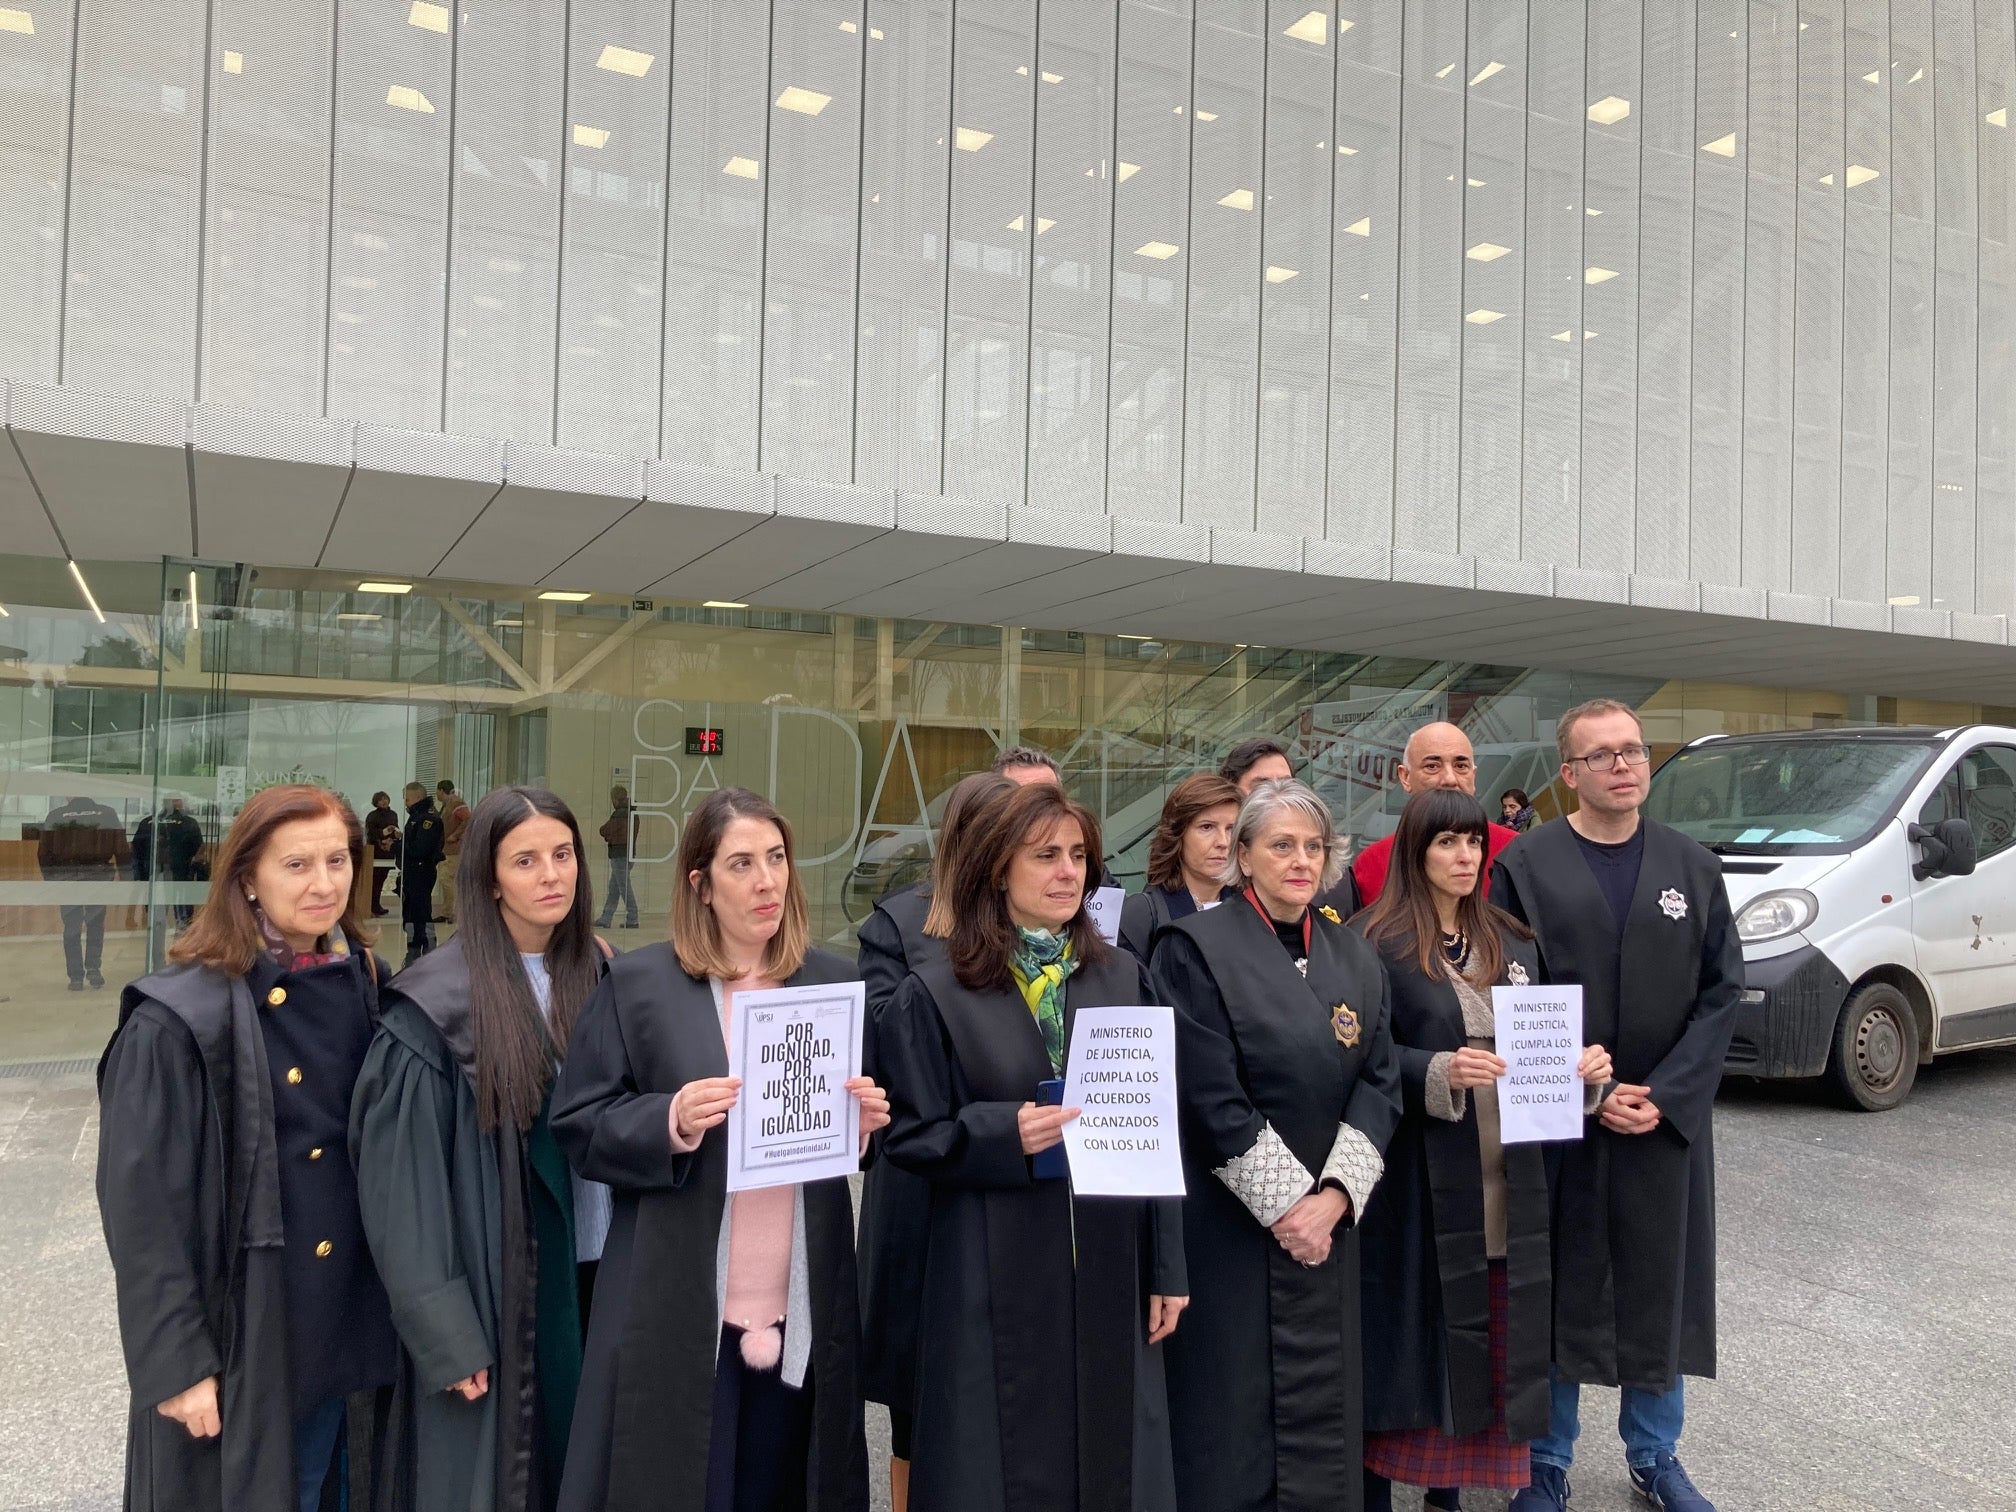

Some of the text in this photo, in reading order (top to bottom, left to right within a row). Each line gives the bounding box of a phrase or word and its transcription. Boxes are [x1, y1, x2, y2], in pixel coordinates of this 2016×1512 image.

[633, 699, 711, 752] CI
[254, 770, 315, 785] XUNTA
[631, 754, 721, 808] DA
[1513, 1002, 1567, 1012] MINISTERIO
[1513, 1020, 1568, 1031] DE JUSTICIA,
[785, 1022, 814, 1043] POR
[1089, 1027, 1153, 1039] MINISTERIO
[761, 1038, 835, 1064] DIGNIDAD,
[1511, 1038, 1572, 1051] ¡CUMPLA LOS
[1086, 1048, 1154, 1061] DE JUSTICIA,
[1517, 1056, 1566, 1067] ACUERDOS
[784, 1058, 812, 1081] POR
[1080, 1071, 1159, 1084] ¡CUMPLA LOS
[1509, 1074, 1571, 1086] ALCANZADOS
[762, 1074, 831, 1100] JUSTICIA,
[1084, 1092, 1151, 1104] ACUERDOS
[1510, 1092, 1570, 1104] CON LOS LAJ!
[783, 1094, 811, 1116] POR
[761, 1109, 831, 1137] IGUALDAD
[1079, 1116, 1159, 1128] ALCANZADOS
[1084, 1138, 1160, 1151] CON LOS LAJ!
